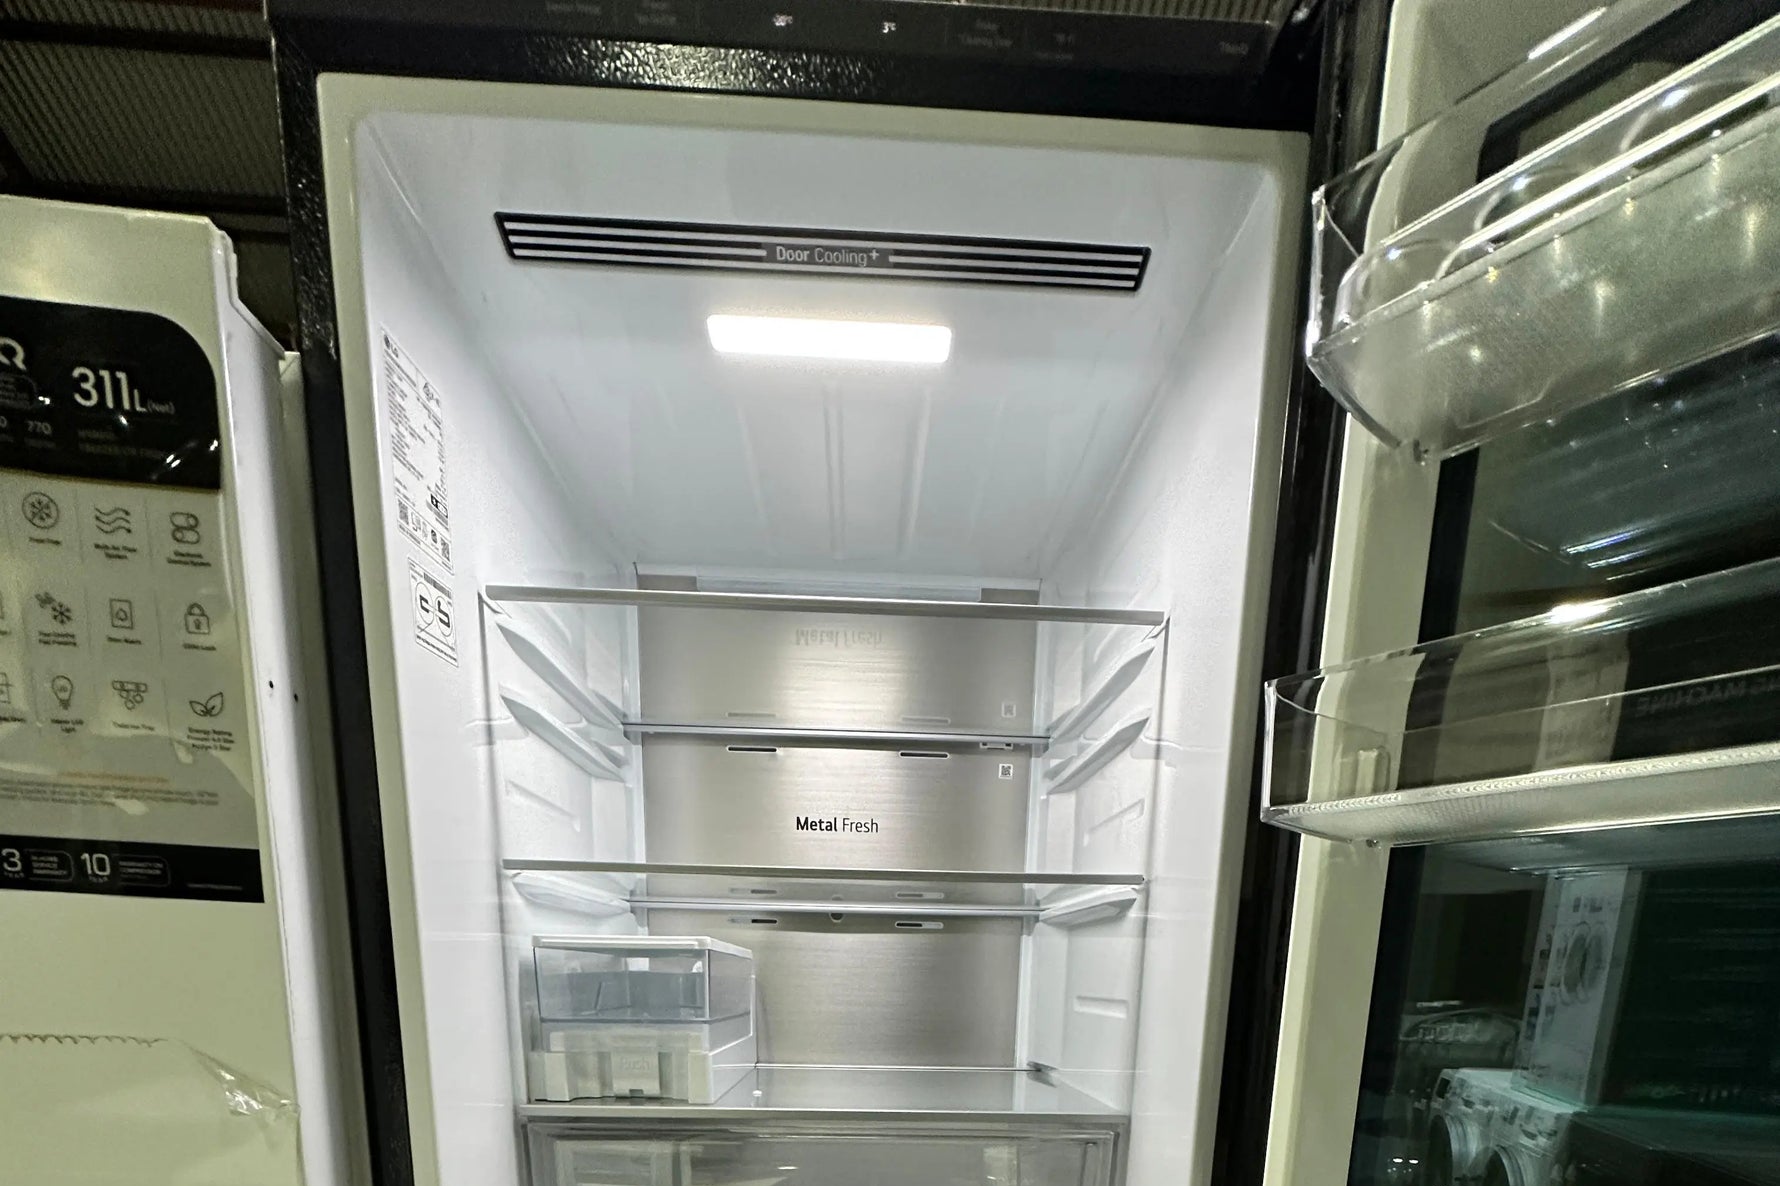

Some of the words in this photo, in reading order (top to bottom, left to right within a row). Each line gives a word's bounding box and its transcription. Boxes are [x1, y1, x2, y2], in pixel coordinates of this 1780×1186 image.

[775, 245, 810, 262] Door
[796, 816, 838, 832] Metal
[842, 817, 879, 833] Fresh
[1, 848, 22, 872] 3
[80, 853, 111, 877] 10
